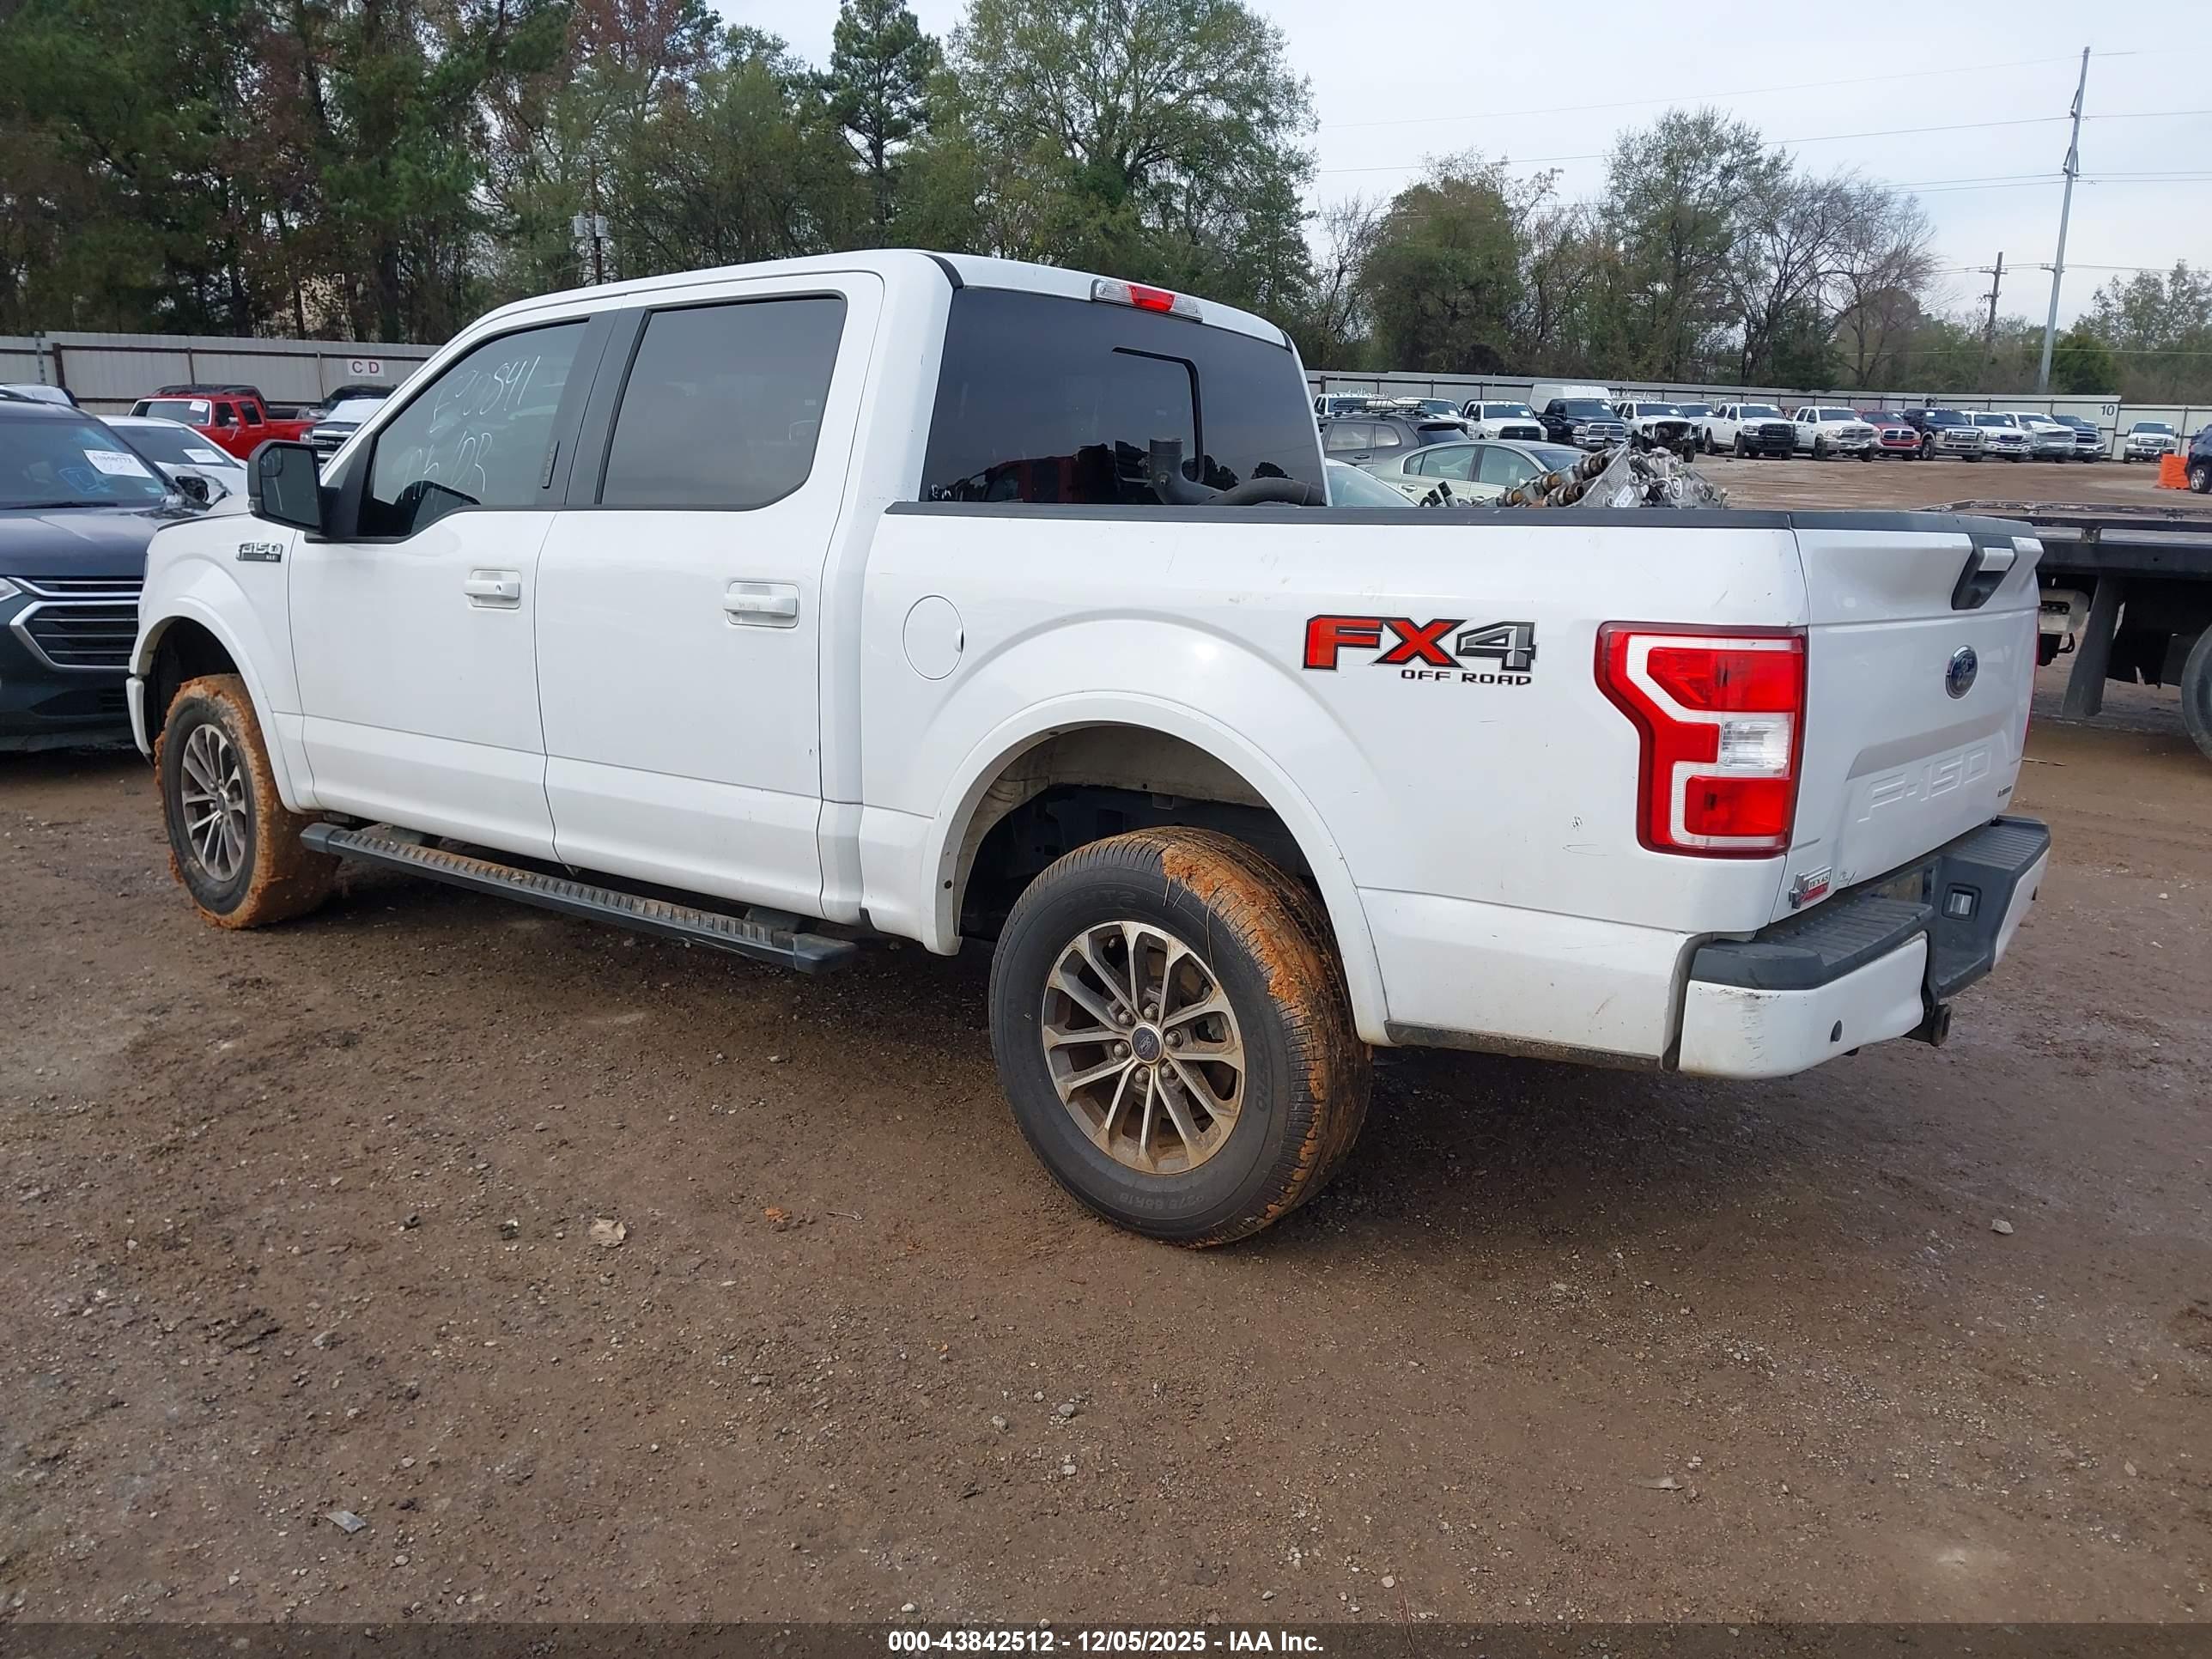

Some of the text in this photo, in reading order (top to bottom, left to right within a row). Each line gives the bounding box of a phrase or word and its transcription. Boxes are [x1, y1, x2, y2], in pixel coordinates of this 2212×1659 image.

[352, 361, 380, 374] C D
[2100, 404, 2115, 416] 10
[1304, 614, 1535, 672] FX4
[1401, 669, 1532, 685] OFF ROAD
[1856, 744, 1992, 823] F-150
[1808, 872, 1830, 889] TEXAS
